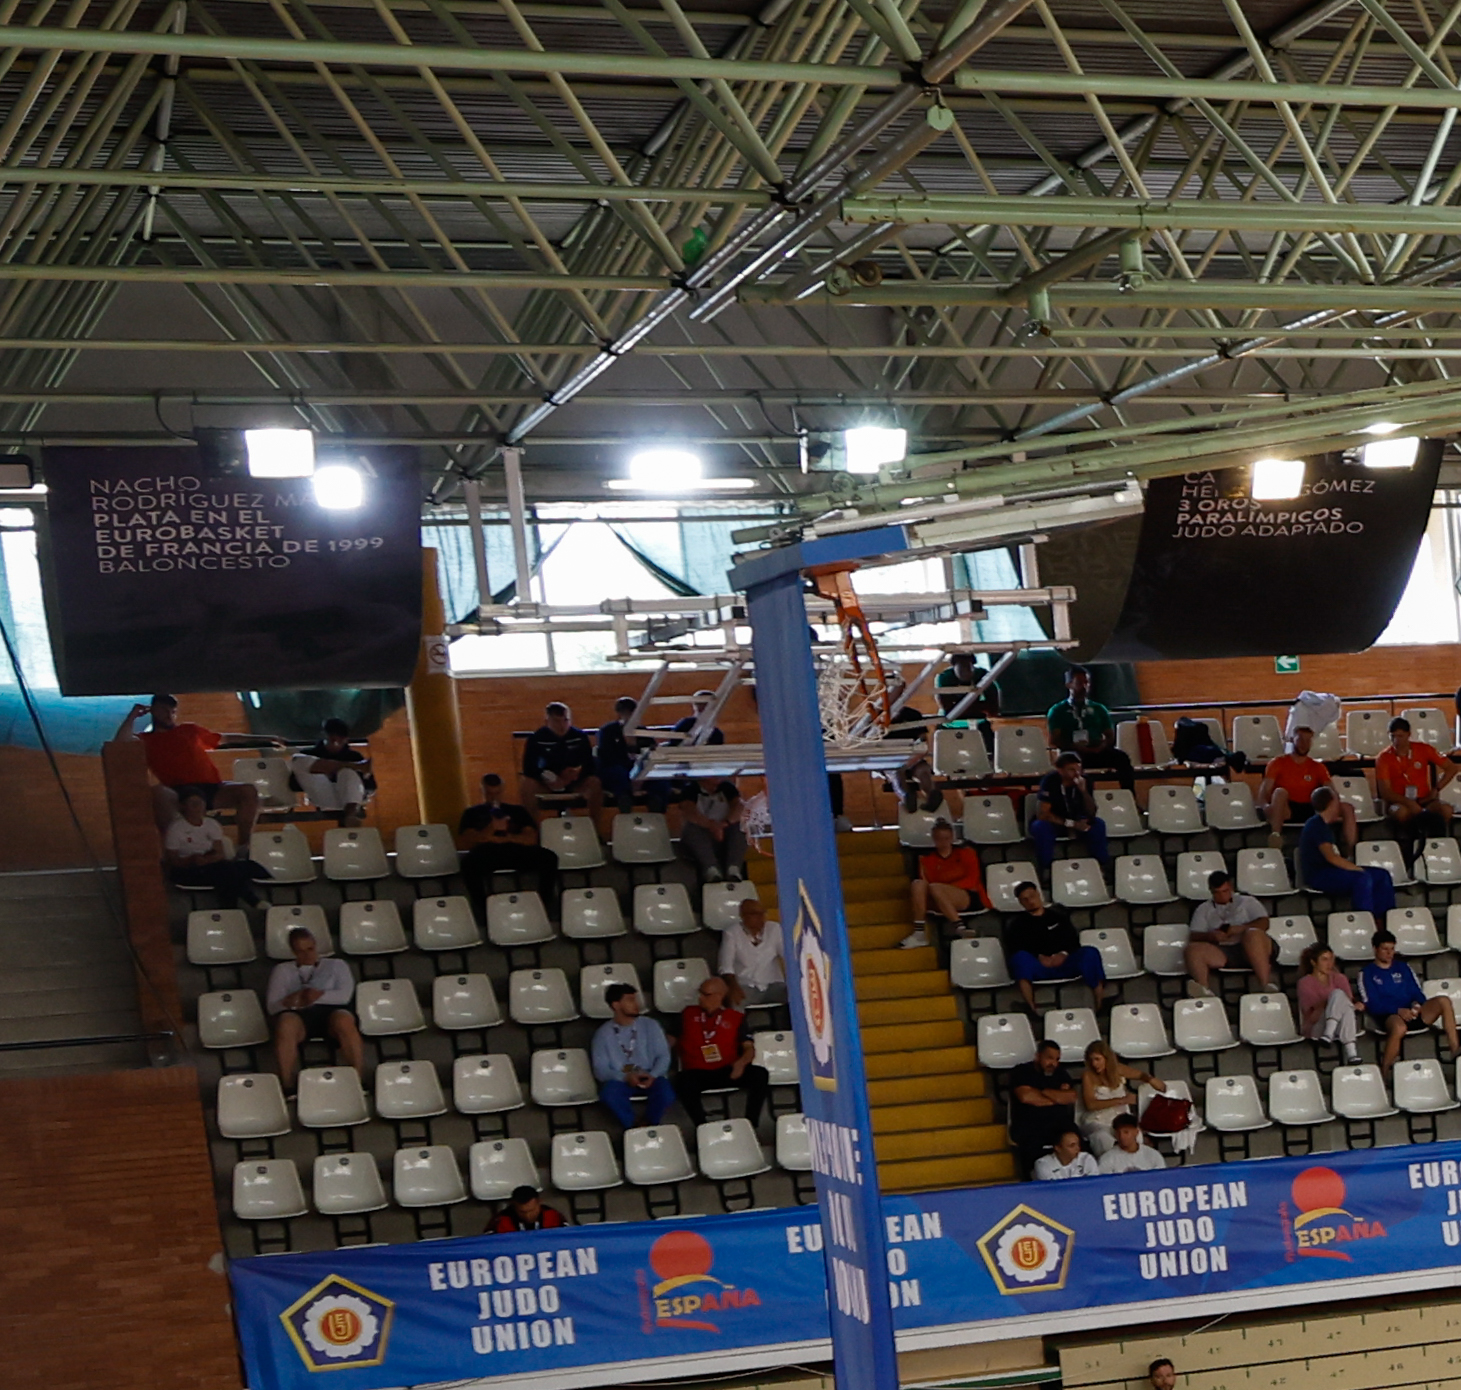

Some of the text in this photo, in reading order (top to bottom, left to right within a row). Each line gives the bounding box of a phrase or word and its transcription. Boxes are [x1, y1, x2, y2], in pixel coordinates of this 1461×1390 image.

[91, 476, 200, 494] NACHO
[92, 489, 264, 512] RODRÍGUEZ
[1178, 498, 1261, 512] 3 OROS
[94, 508, 270, 527] PLATA EN EL
[1177, 507, 1342, 525] PARALÍMPICOS
[96, 525, 284, 544] EUROBASKET
[1173, 521, 1364, 539] JUDO ADAPTADO
[97, 536, 385, 559] DE FRANCIA DE 1999
[99, 555, 291, 574] BALONCESTO
[1102, 1181, 1247, 1221] EUROPEAN
[1144, 1215, 1215, 1249] JUDO
[428, 1247, 597, 1291] EUROPEAN
[1139, 1246, 1228, 1280] UNION
[477, 1285, 559, 1321] JUDO
[471, 1318, 575, 1356] UNION
